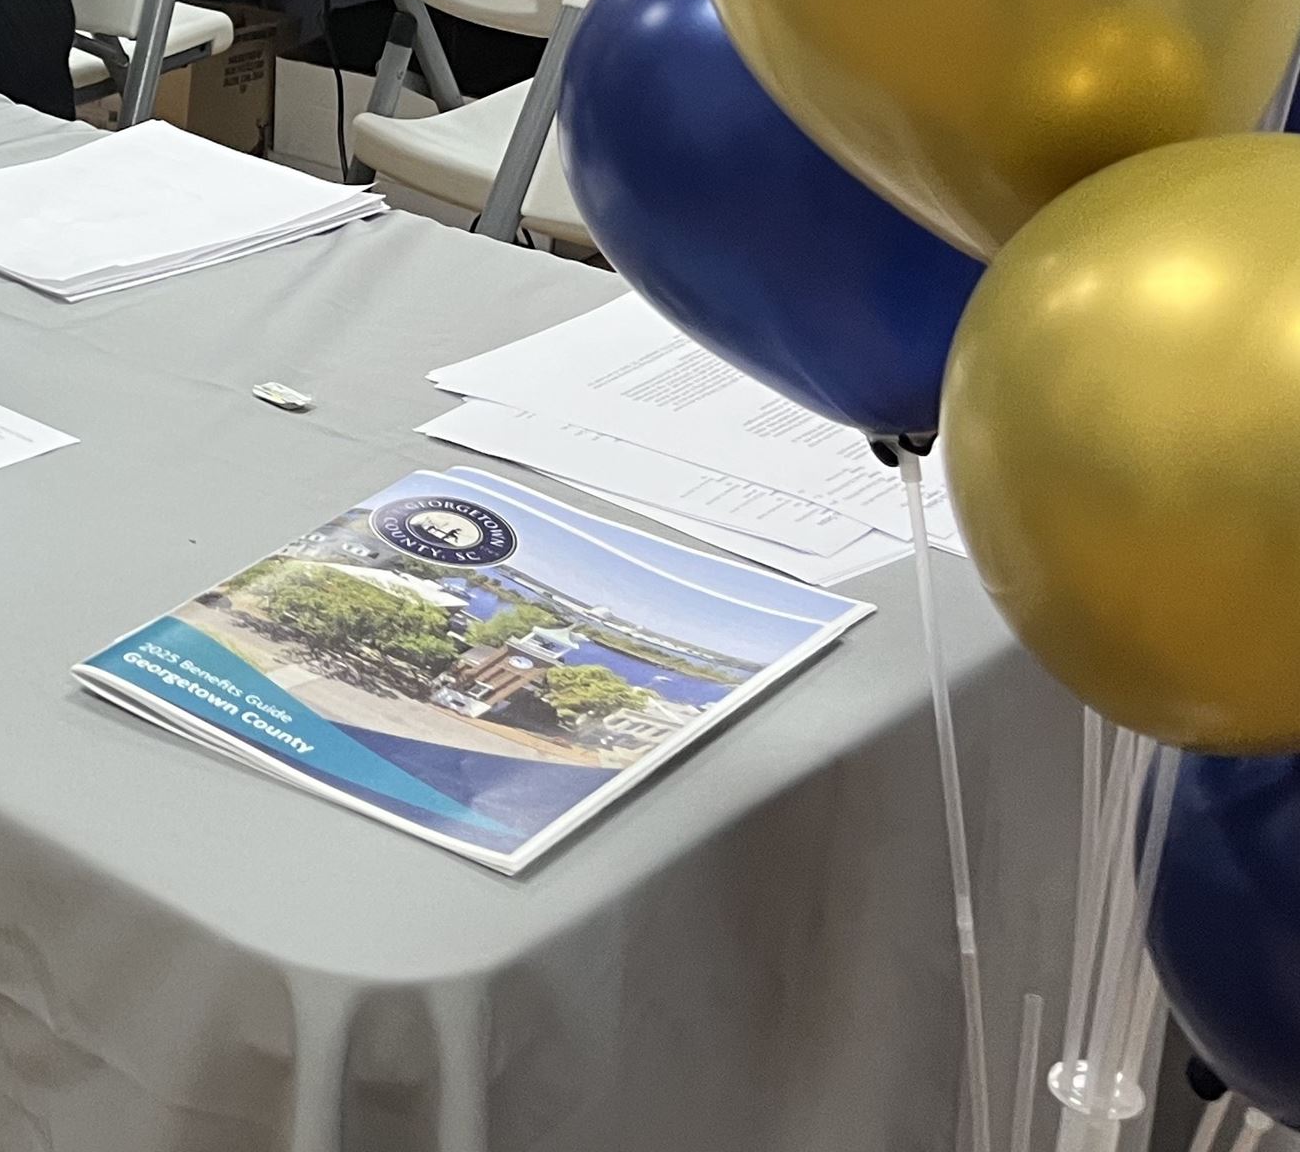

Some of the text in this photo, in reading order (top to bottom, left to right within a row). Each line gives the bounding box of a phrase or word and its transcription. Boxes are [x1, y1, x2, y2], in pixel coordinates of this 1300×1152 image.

[404, 499, 506, 548] GEORGETOWN
[455, 551, 481, 561] SC
[123, 652, 315, 753] Georgetown County
[139, 642, 292, 723] 2025 Benefits Guide
